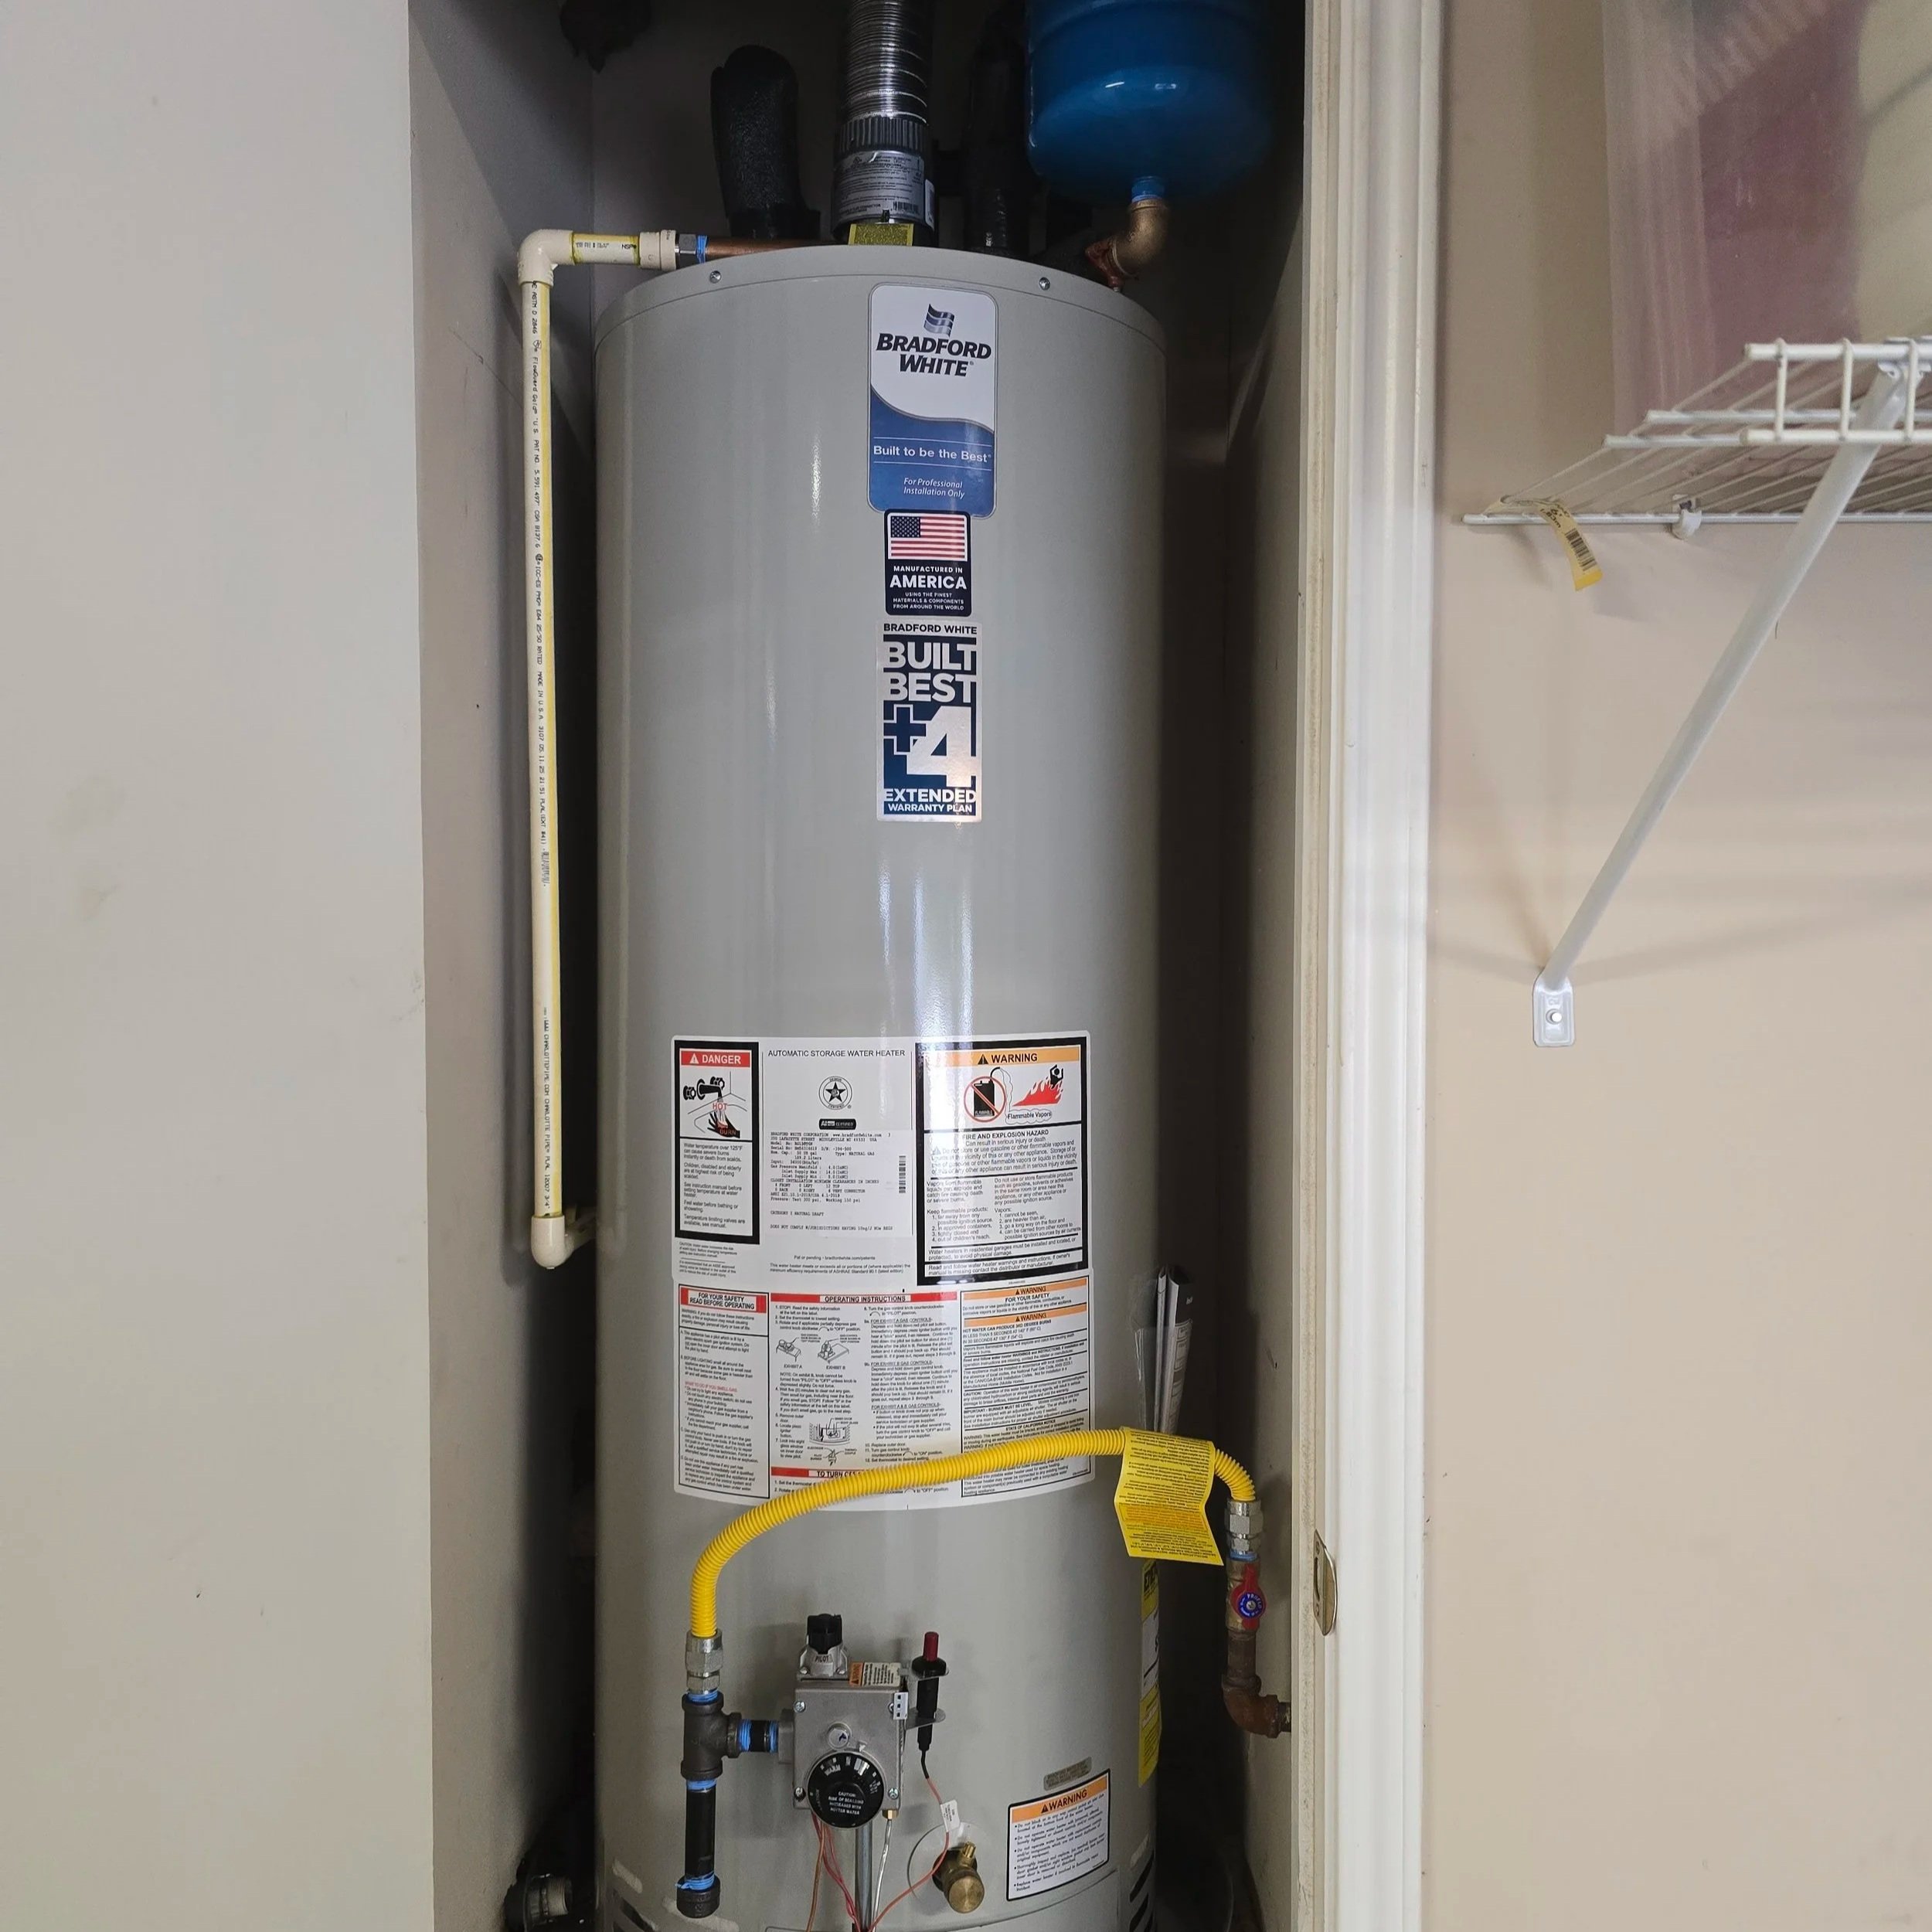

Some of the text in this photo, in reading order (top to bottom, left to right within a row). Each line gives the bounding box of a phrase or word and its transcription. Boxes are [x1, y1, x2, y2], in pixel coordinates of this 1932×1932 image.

[876, 332, 992, 359] BRADFORD
[900, 354, 969, 377] WHITE
[873, 445, 988, 462] Built to be the Best
[917, 478, 963, 488] Professional
[903, 487, 965, 500] Installation Only
[889, 575, 967, 589] AMERICA
[883, 623, 978, 634] BRADFORD WHITE
[883, 640, 976, 671] BUILT
[883, 671, 976, 704] BEST
[884, 788, 977, 803] EXTENDED
[888, 804, 972, 813] WARRANTY PLAN
[702, 1054, 741, 1065] DANGER
[991, 1053, 1037, 1063] WARNING
[1020, 1286, 1046, 1294] WARNING
[703, 1298, 723, 1307] BEFORE
[1020, 1312, 1046, 1321] WARNING
[1049, 1789, 1087, 1810] WARNING
